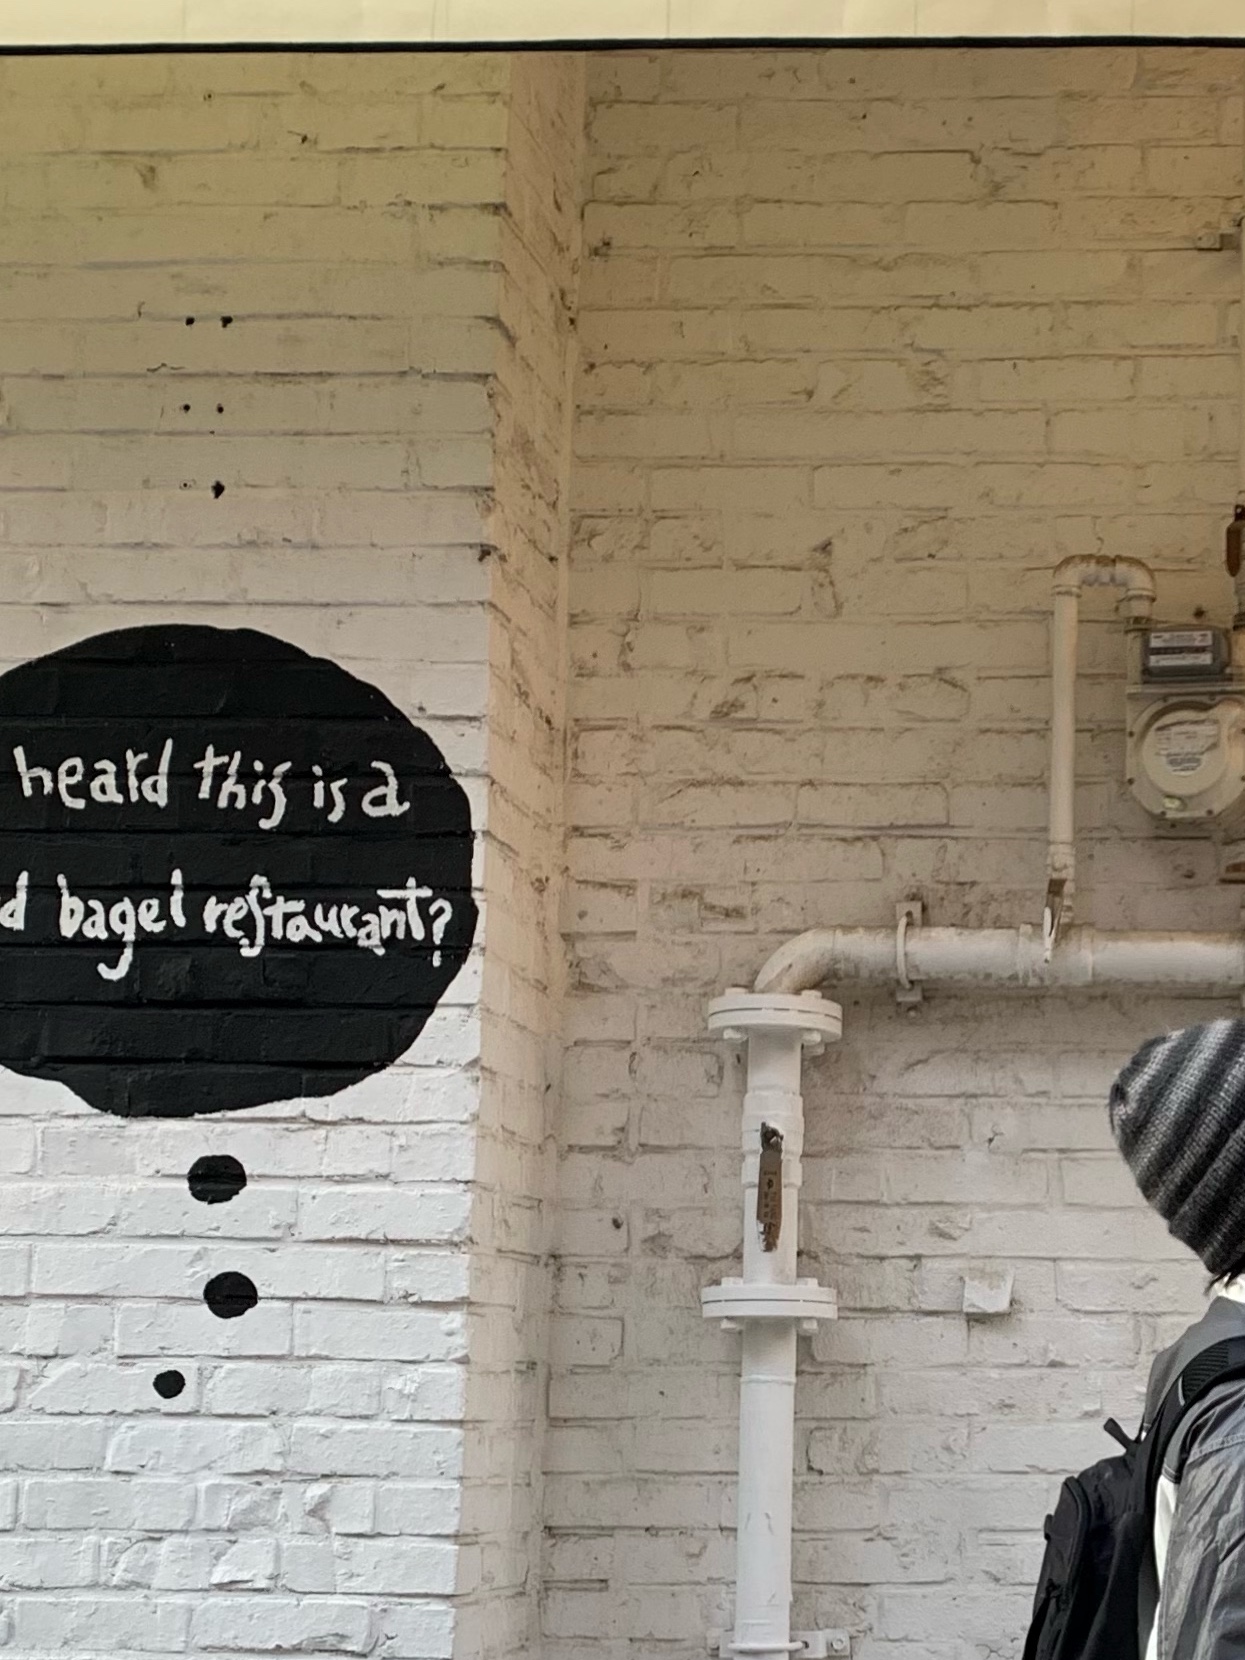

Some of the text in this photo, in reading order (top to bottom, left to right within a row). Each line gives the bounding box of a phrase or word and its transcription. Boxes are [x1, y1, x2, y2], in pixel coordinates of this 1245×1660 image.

[14, 739, 410, 829] heard this is a
[57, 869, 186, 981] bagel
[203, 875, 452, 967] restaurant?
